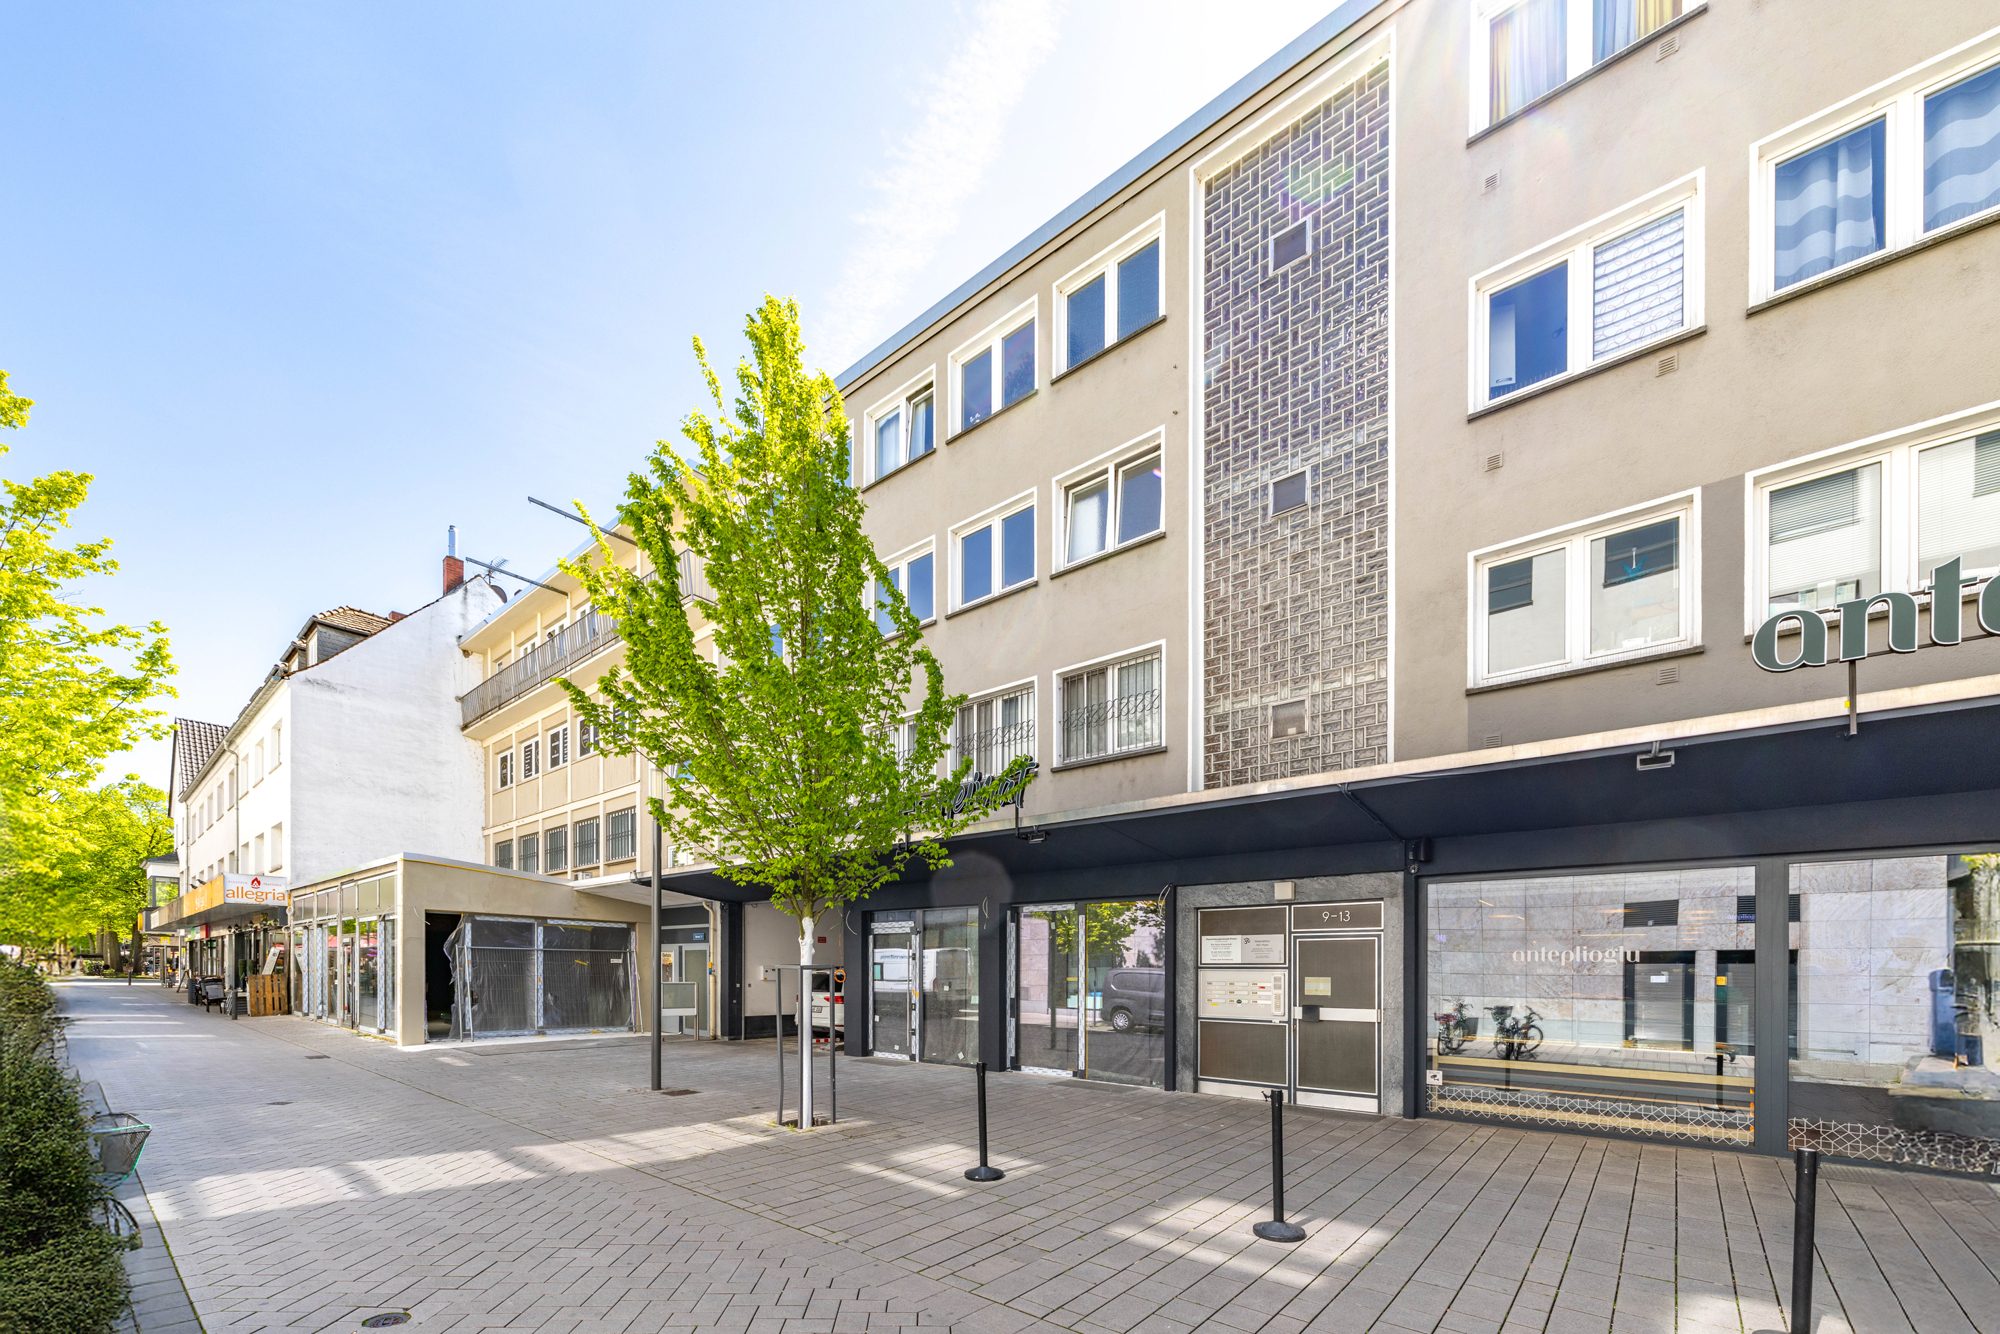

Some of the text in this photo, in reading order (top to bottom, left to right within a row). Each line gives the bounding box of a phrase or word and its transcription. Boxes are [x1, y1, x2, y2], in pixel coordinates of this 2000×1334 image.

[226, 886, 285, 902] allegria
[1322, 910, 1351, 922] 9-13
[1512, 945, 1640, 967] anteplioglu
